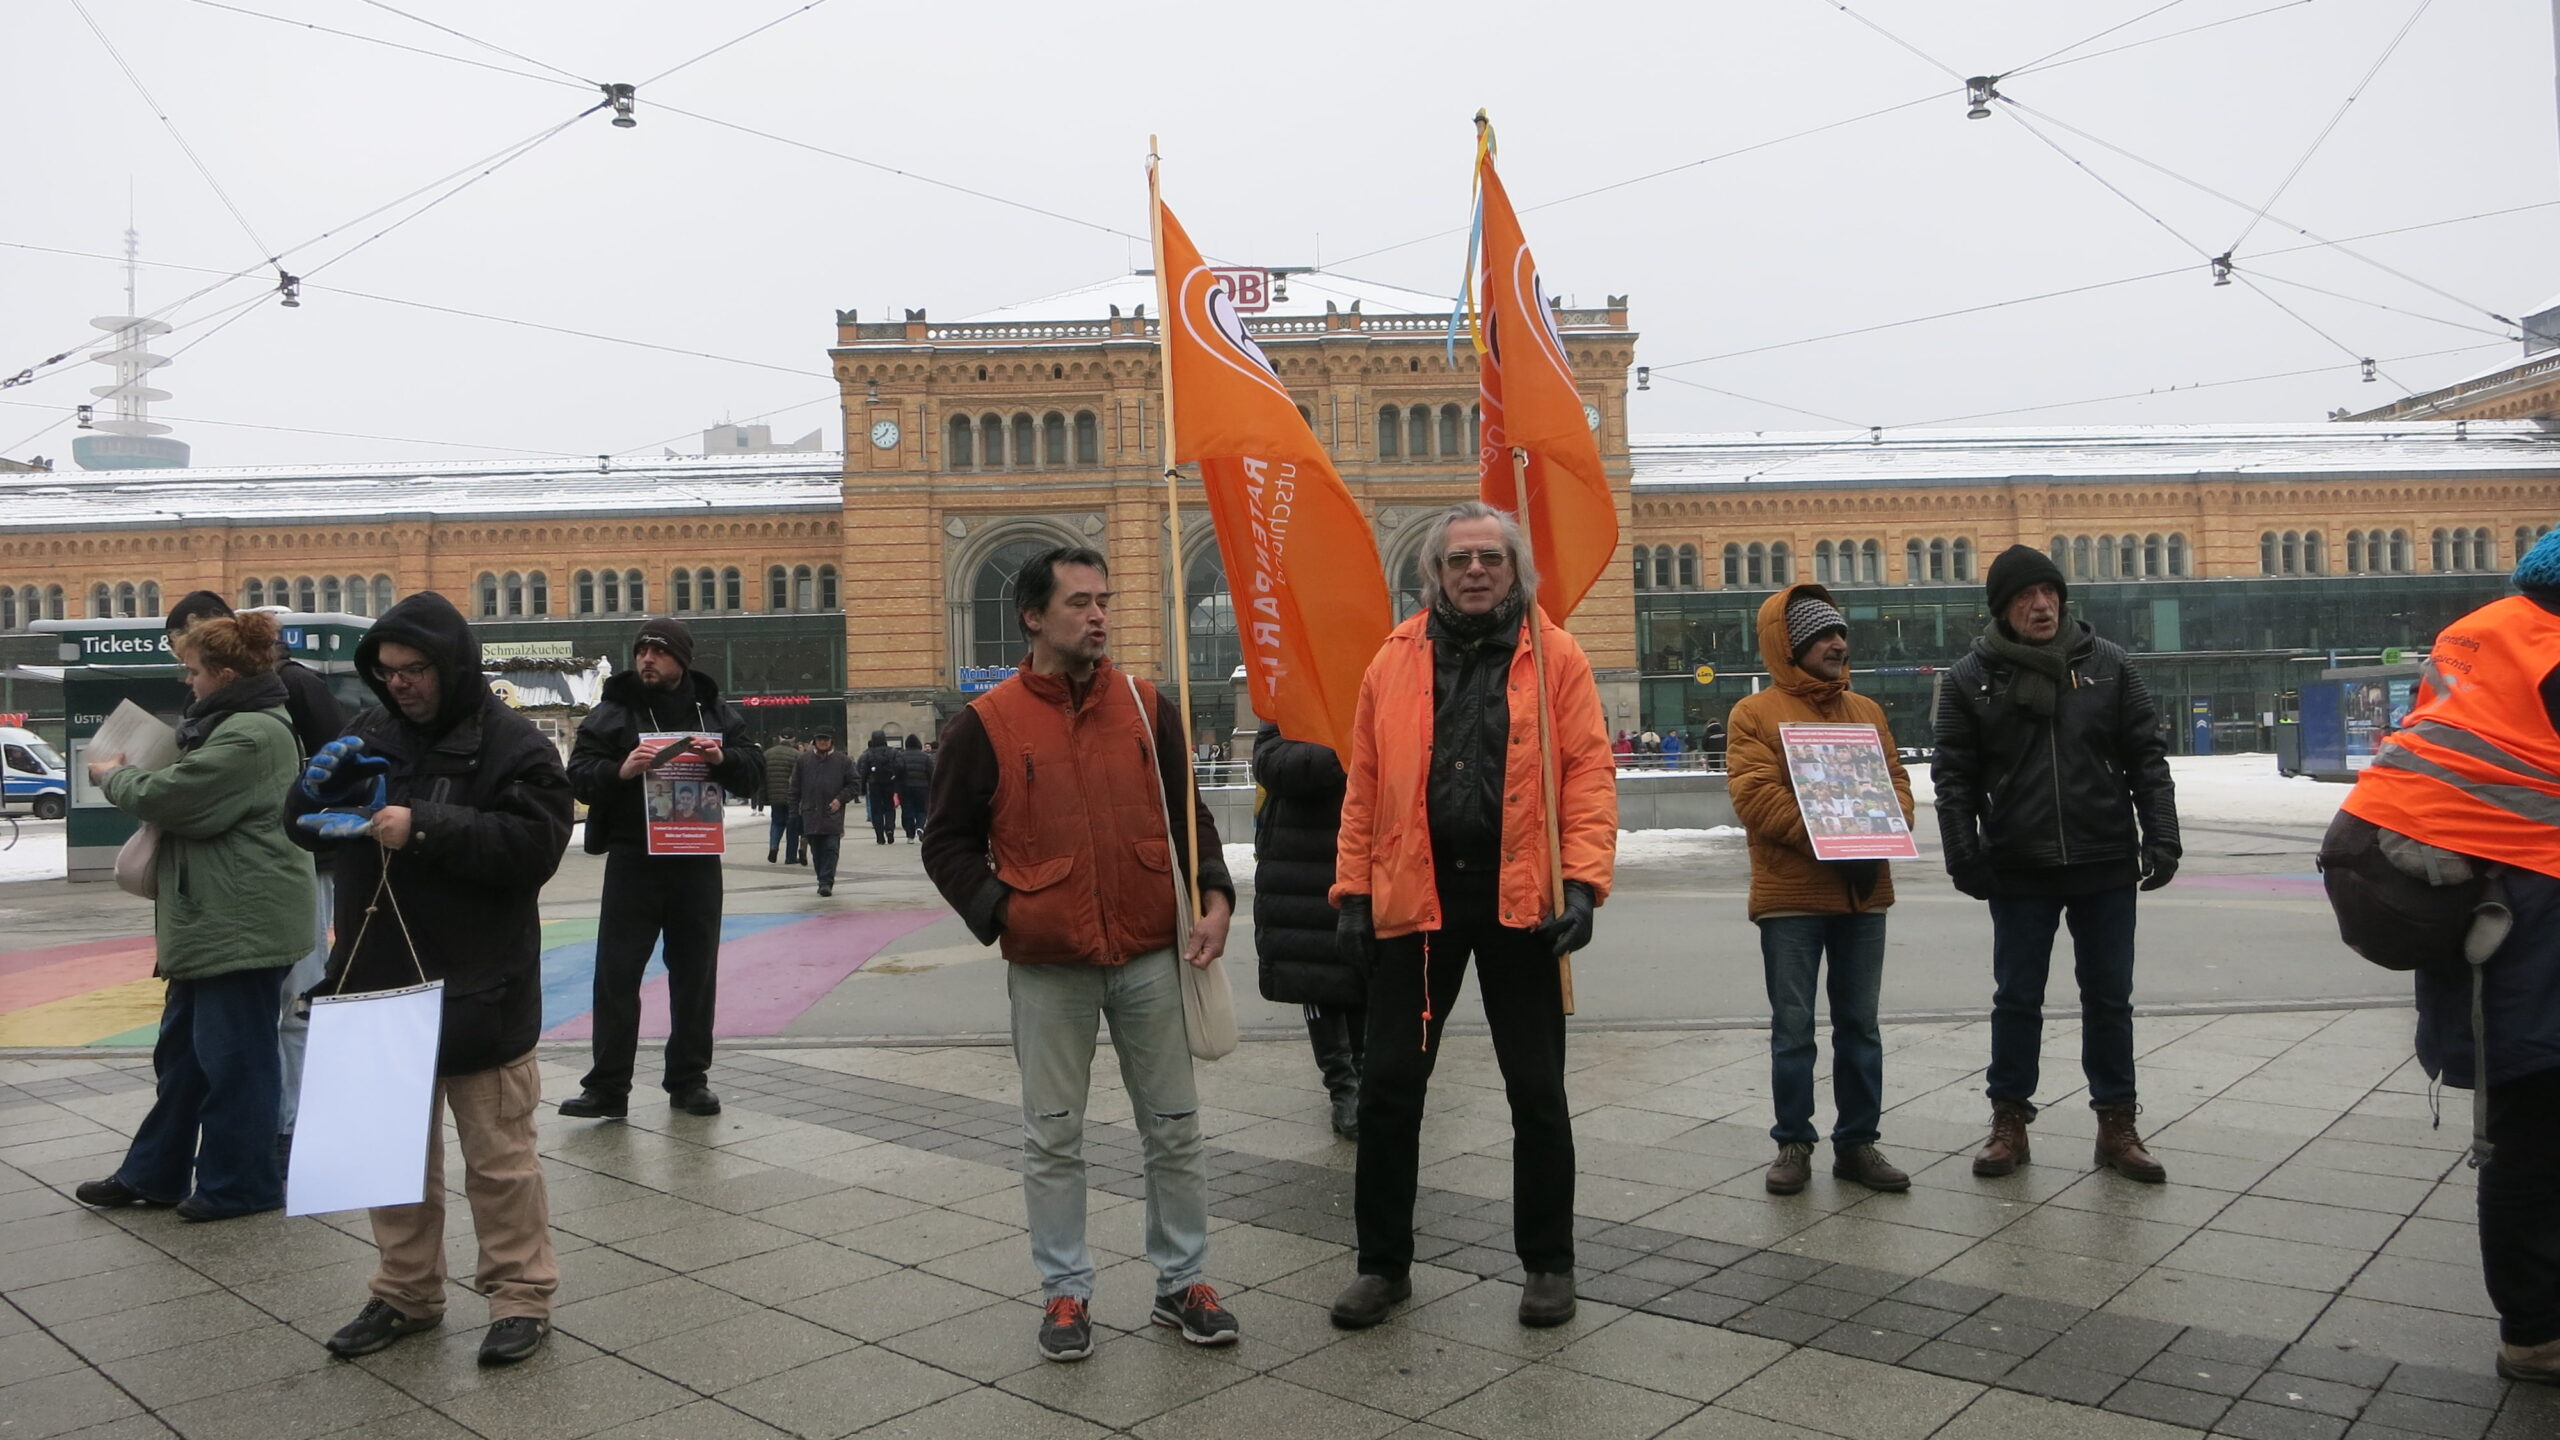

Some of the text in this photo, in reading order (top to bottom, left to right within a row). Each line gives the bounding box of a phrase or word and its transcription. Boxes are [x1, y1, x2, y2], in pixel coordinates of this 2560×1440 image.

[1213, 274, 1262, 304] DB
[82, 634, 172, 653] Tickets &
[286, 632, 299, 645] U
[483, 643, 573, 656] Schmalzkuchen
[960, 665, 987, 680] Mein
